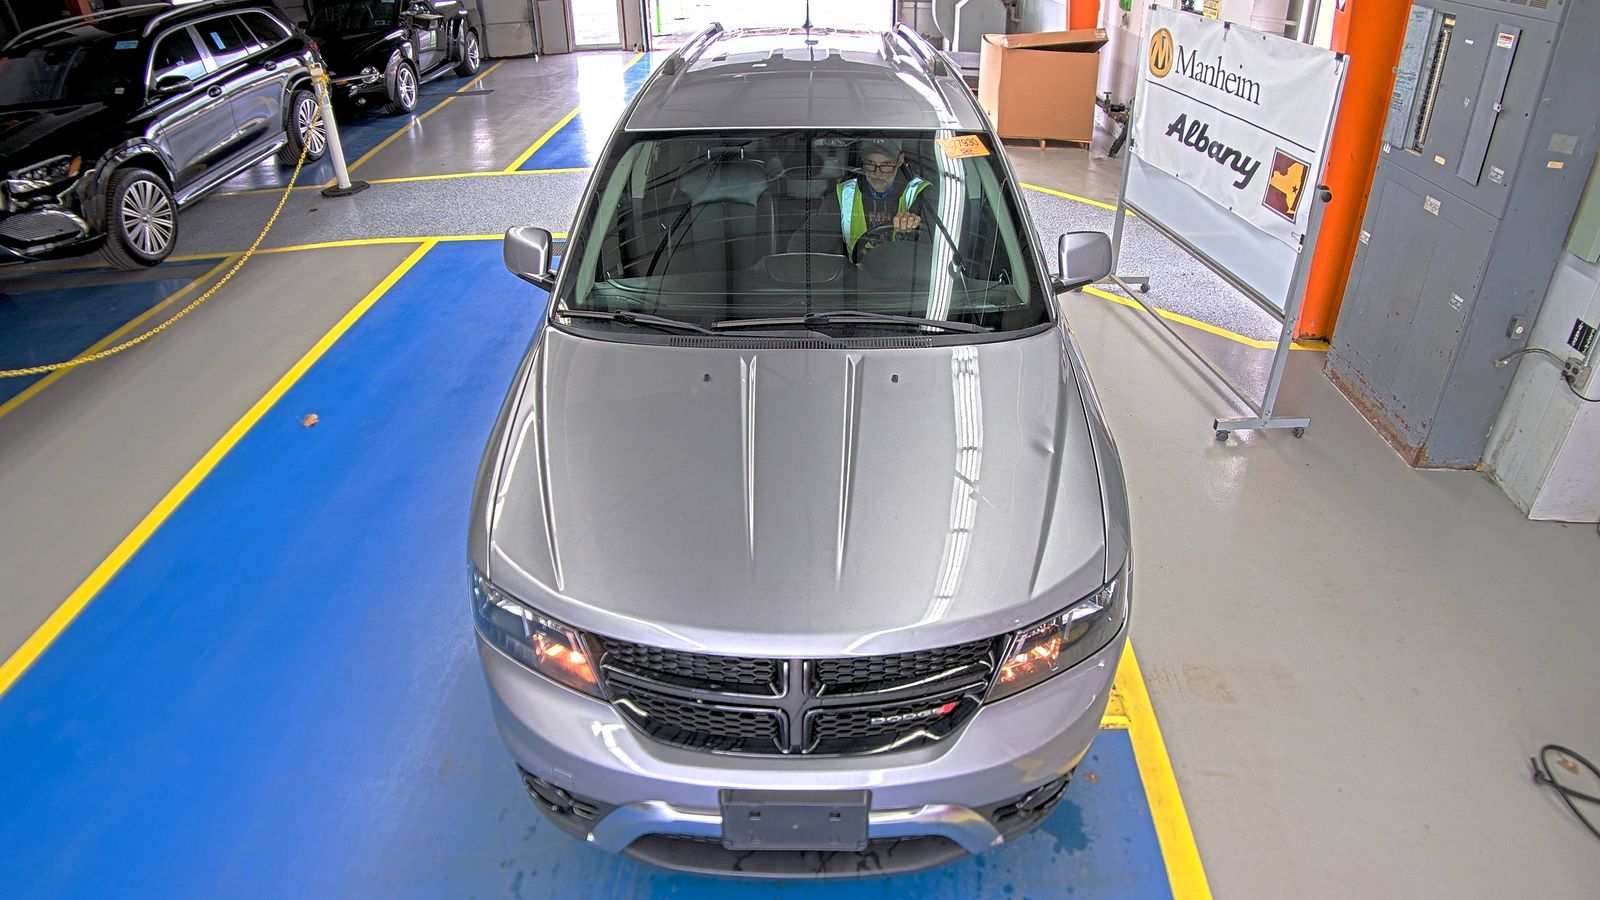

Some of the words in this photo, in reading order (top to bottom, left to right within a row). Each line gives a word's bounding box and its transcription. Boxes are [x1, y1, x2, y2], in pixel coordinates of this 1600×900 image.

[1175, 45, 1260, 106] Manheim
[1165, 113, 1261, 189] Albany
[871, 708, 940, 725] DODGE
